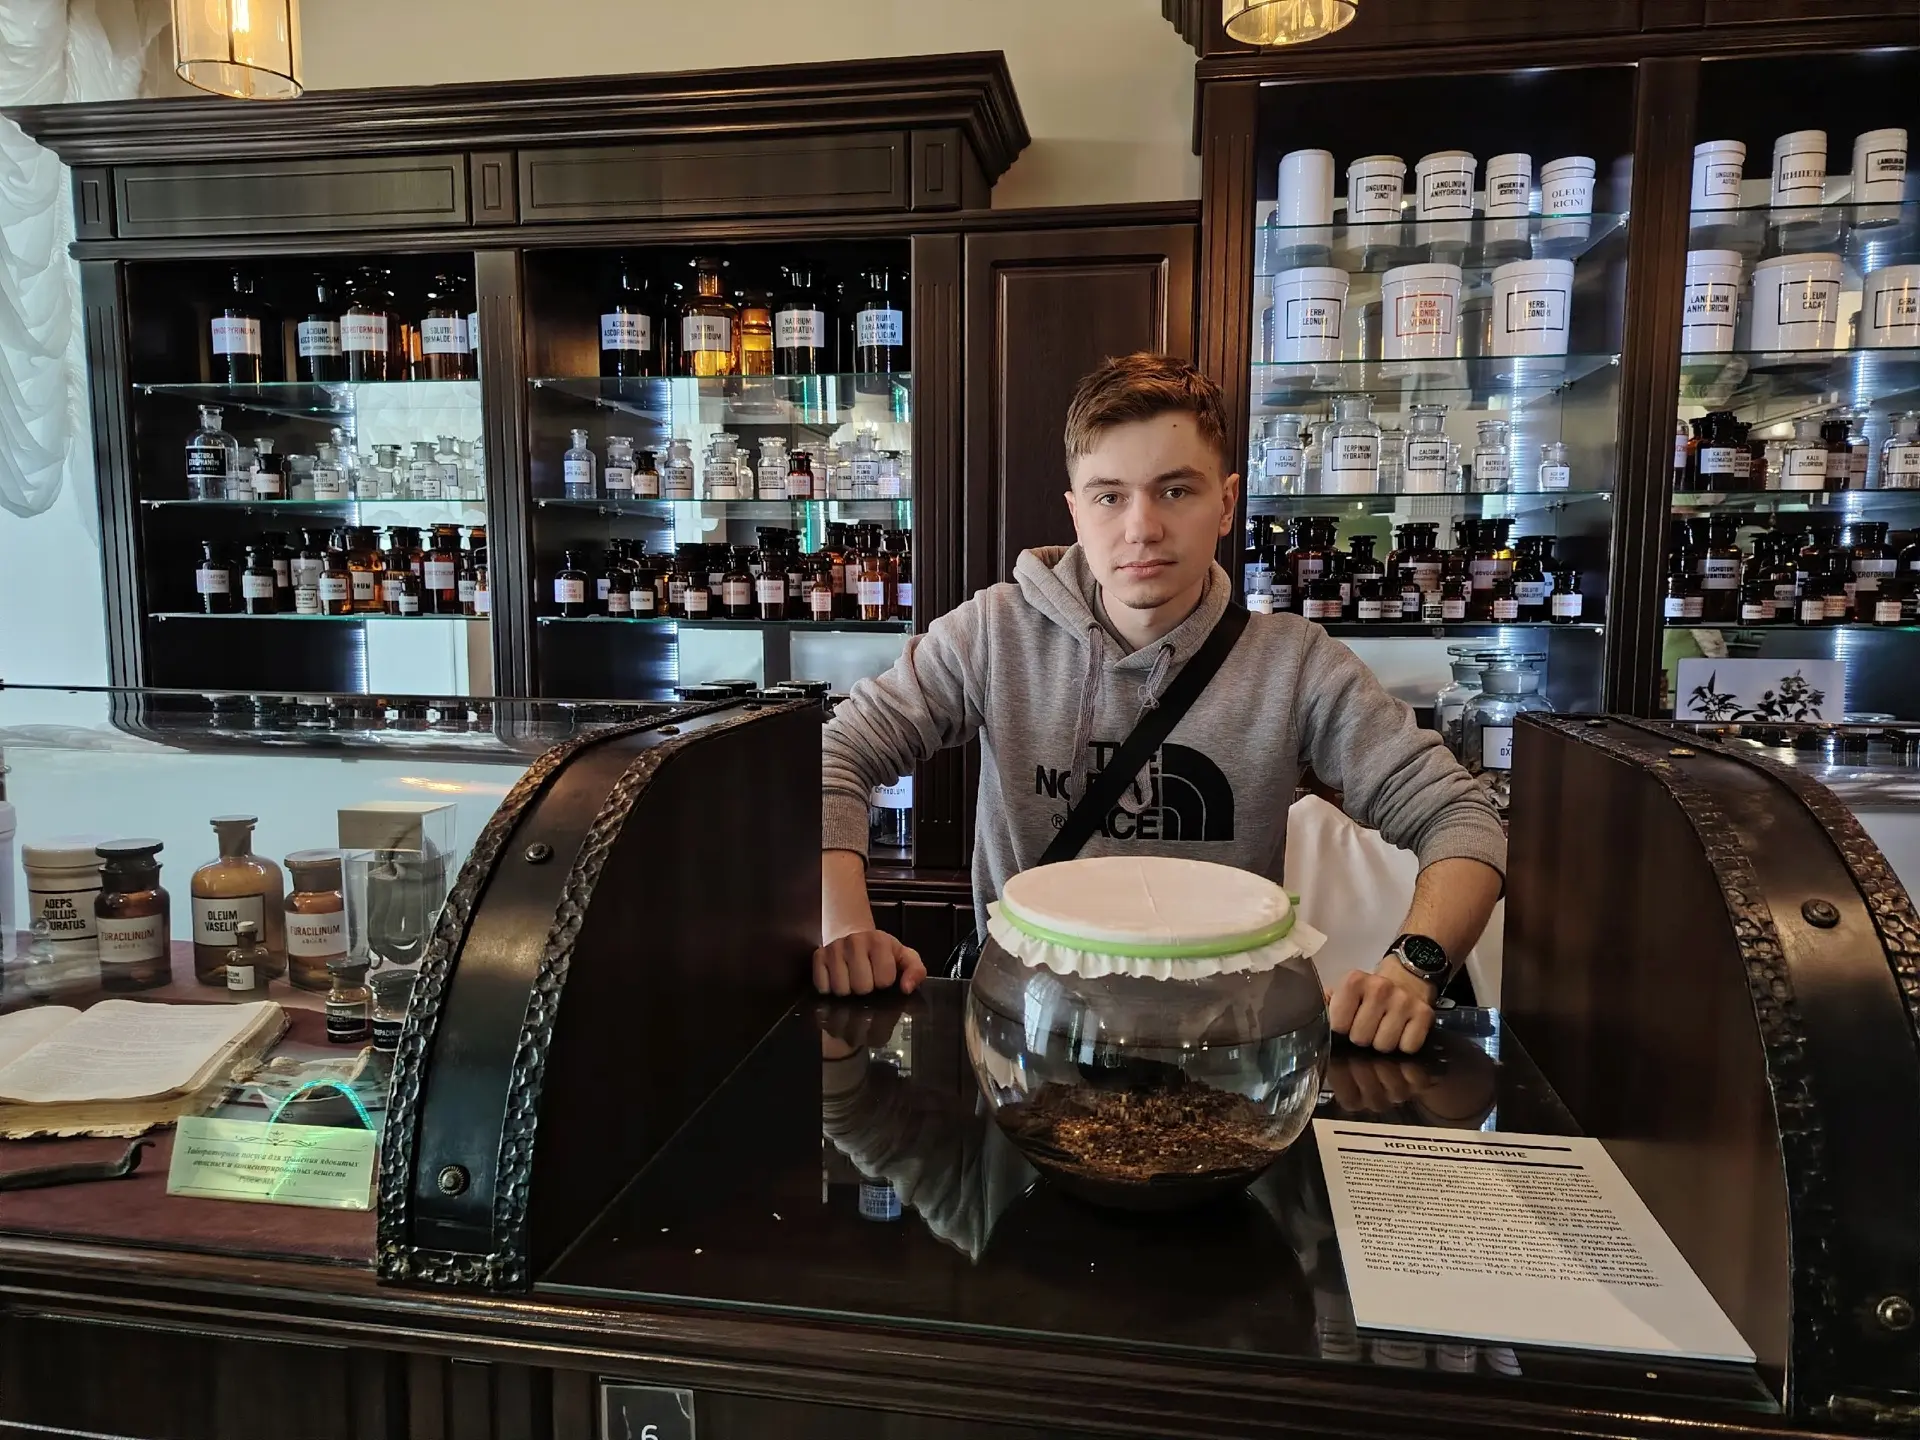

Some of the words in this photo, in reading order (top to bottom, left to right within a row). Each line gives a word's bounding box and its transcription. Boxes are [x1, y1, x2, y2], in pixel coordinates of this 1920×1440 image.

[1551, 187, 1587, 199] OLEUM
[1553, 198, 1584, 209] RICINI
[784, 317, 812, 325] NATRIUM
[44, 898, 72, 909] ADEPS
[42, 909, 77, 920] SUILLUS
[208, 910, 238, 920] OLEUM
[1384, 1142, 1528, 1158] КРОВОПУСКАНИЕ
